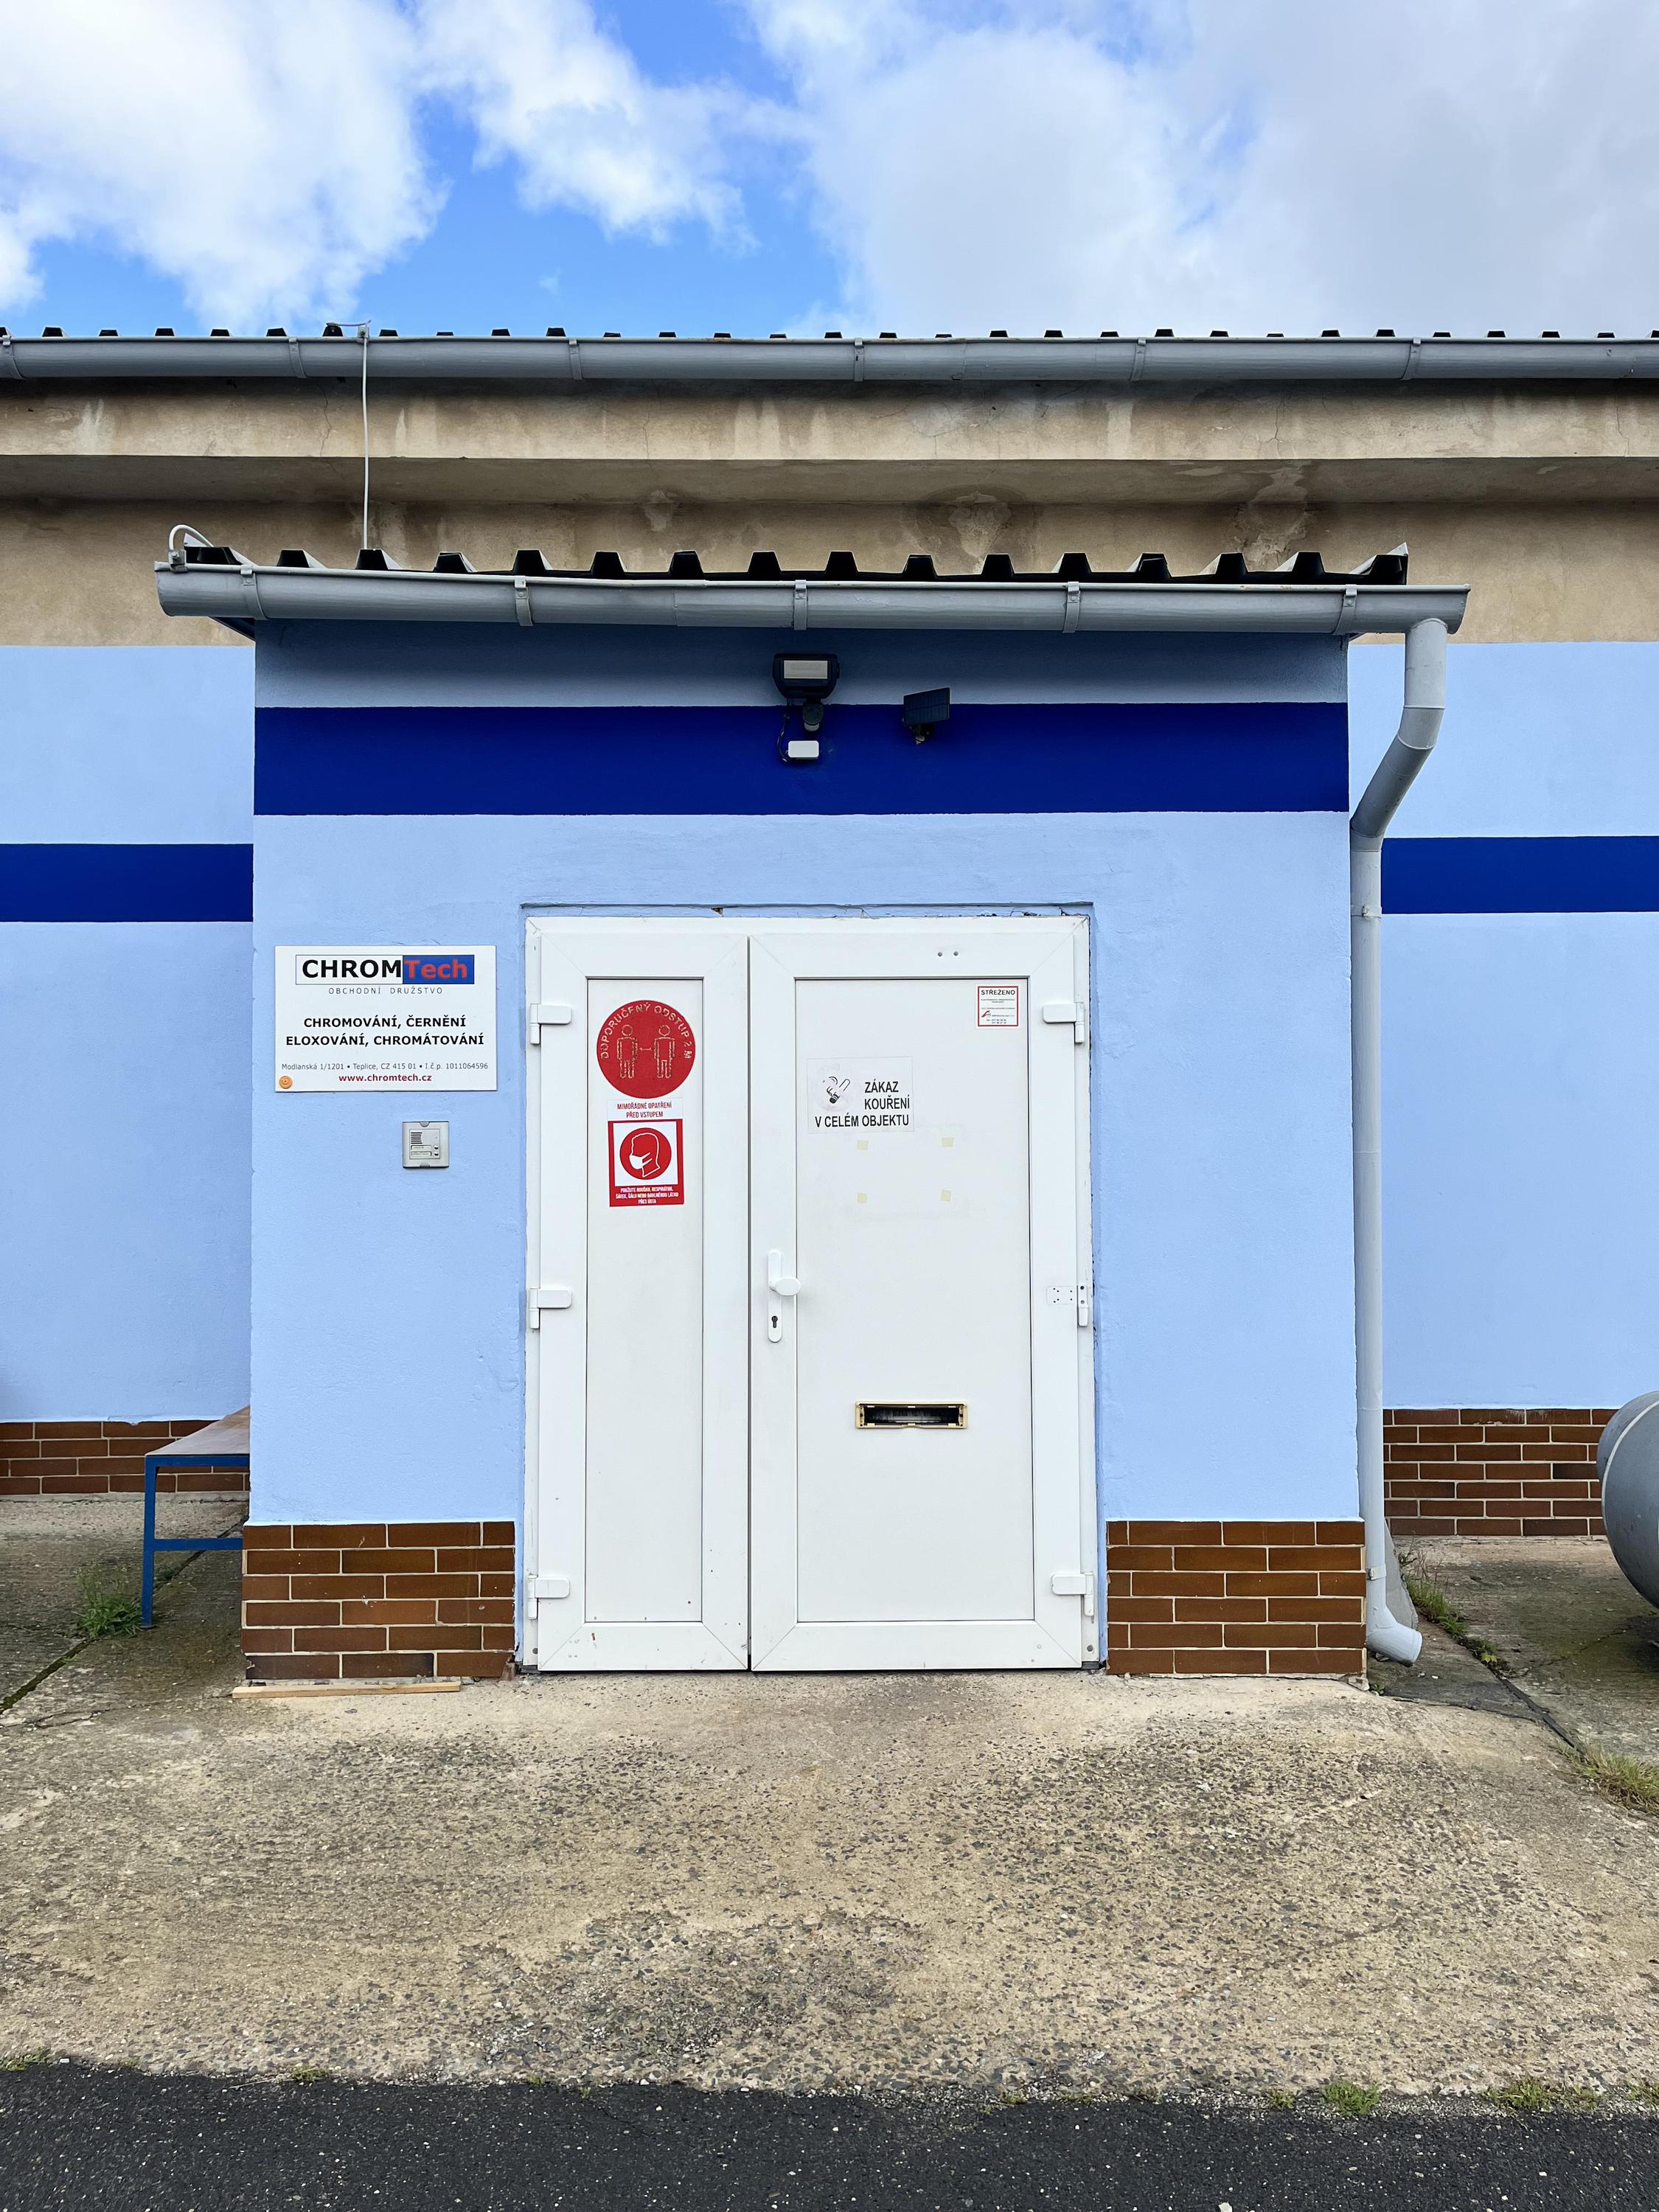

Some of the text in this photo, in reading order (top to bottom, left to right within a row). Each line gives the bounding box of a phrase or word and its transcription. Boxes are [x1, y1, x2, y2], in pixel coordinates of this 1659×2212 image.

[302, 959, 467, 979] CHROMTech
[328, 986, 443, 995] OBCHODNÍ DRUŽSTVO
[304, 1015, 466, 1029] CHROMOVÁNÍ, ČERNĚNÍ
[654, 1005, 690, 1037] ODSTUP
[285, 1032, 484, 1047] ELOXOVÁNÍ, CHROMÁTOVÁNÍ
[353, 1062, 378, 1071] Teplice,
[338, 1074, 432, 1082] www.chromtech.cz
[864, 1078, 899, 1093] ZÁKAZ
[617, 1101, 672, 1110] MIMOŘÁDNÉ OPATŘENÍ
[864, 1094, 910, 1110] KOUŘENÍ
[815, 1113, 909, 1127] V CELÉM OBJEKTU
